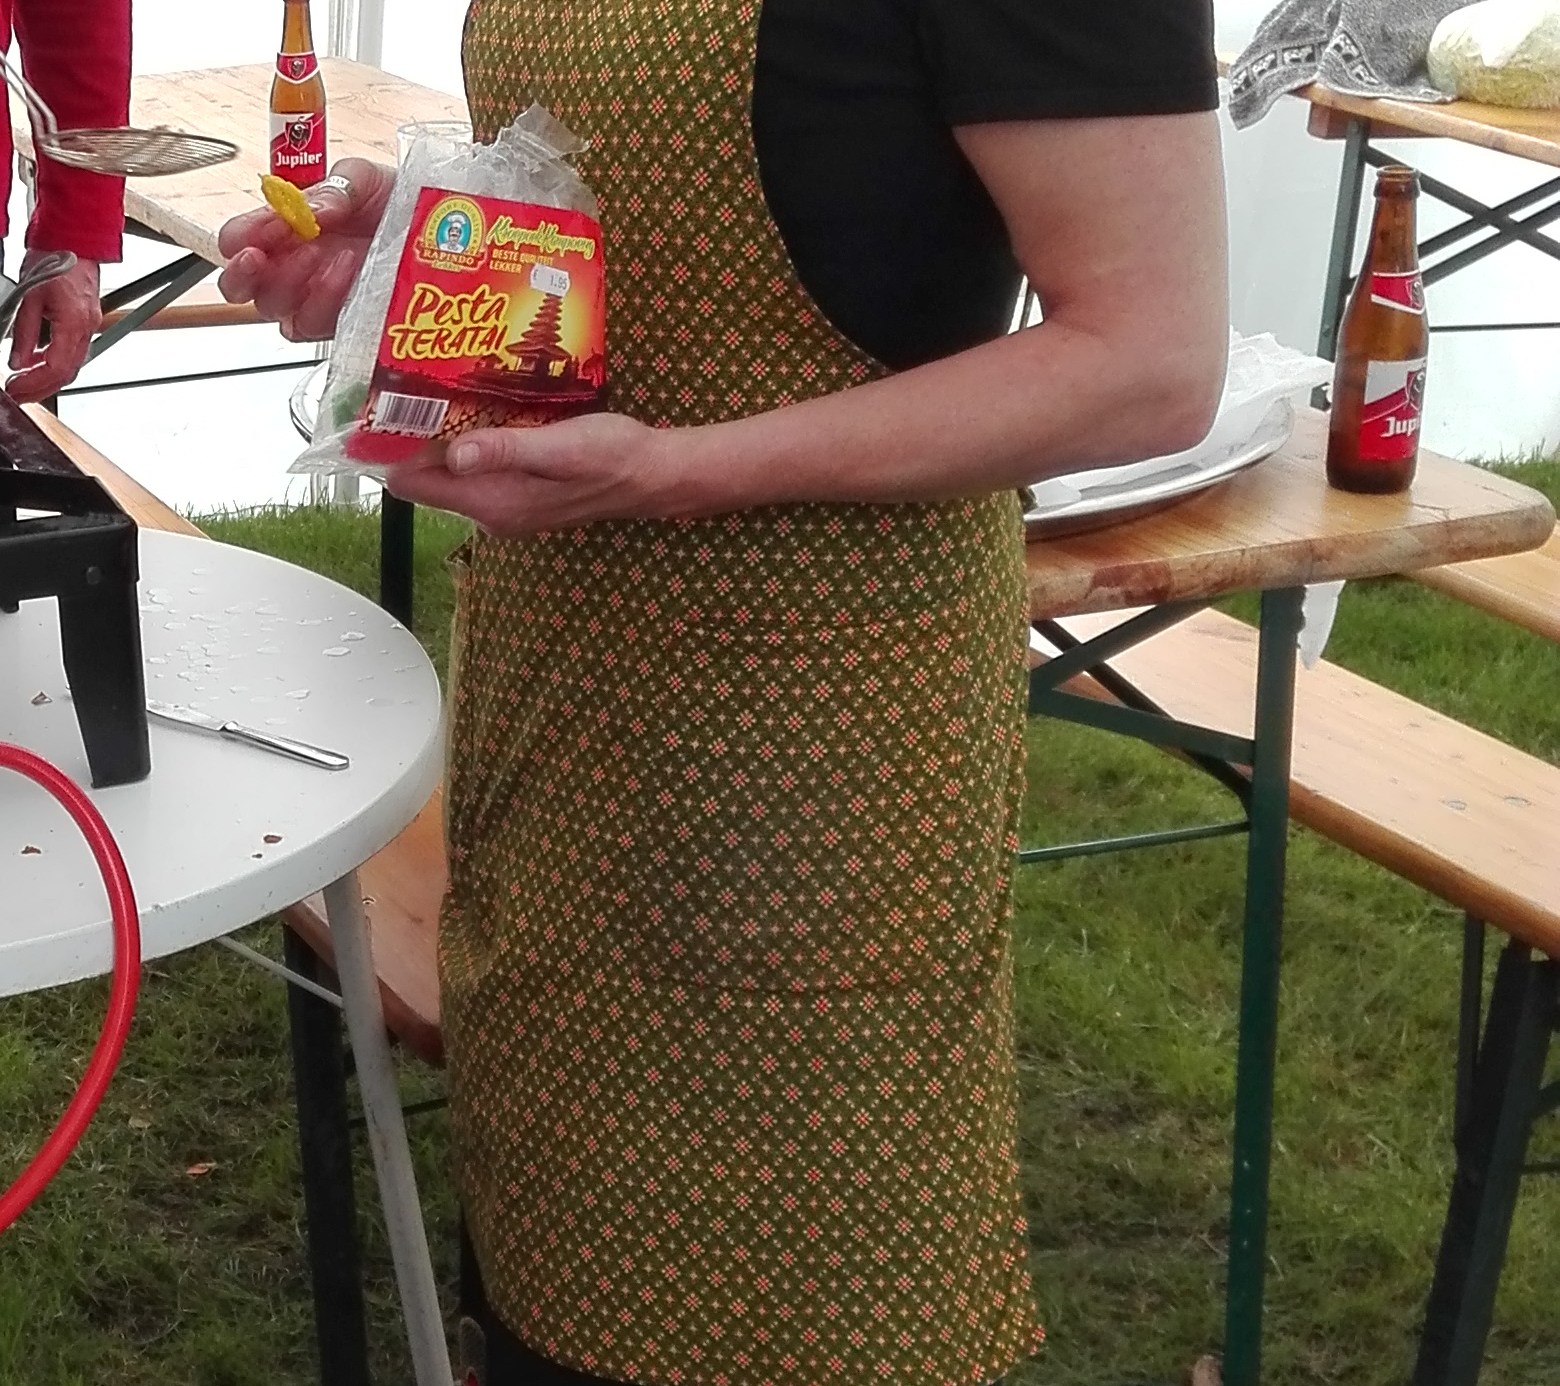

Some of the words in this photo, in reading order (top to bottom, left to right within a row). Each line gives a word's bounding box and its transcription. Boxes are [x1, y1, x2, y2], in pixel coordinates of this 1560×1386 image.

[275, 151, 323, 169] Jupiler
[423, 249, 475, 266] RAPINDO
[492, 248, 519, 261] BESTE
[489, 260, 522, 274] LEKKER
[550, 274, 568, 291] 1.95
[407, 286, 507, 326] Pesta
[390, 323, 508, 355] TERATAI
